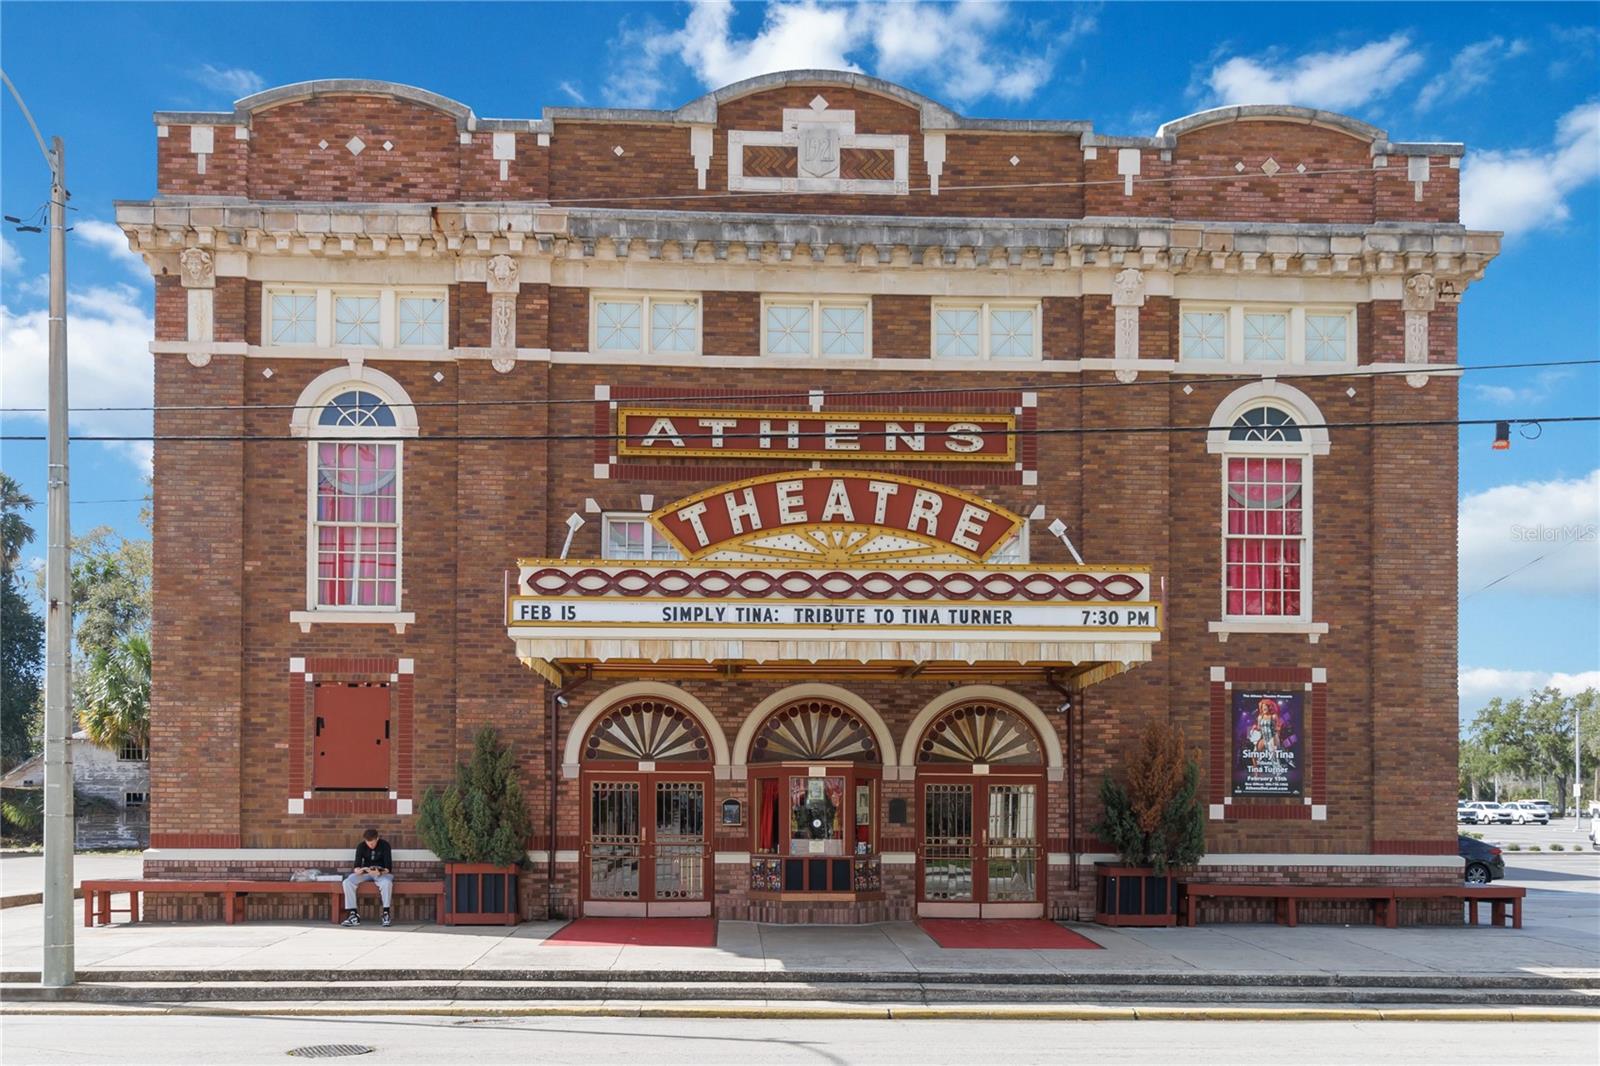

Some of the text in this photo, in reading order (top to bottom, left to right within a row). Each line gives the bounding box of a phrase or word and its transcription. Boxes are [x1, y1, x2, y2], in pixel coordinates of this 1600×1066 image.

[640, 418, 985, 453] ATHENS
[678, 479, 991, 552] THEATRE
[520, 605, 1149, 625] FEB 15 SIMPLY TINA: TRIBUTE TO TINA TURNER 7:30 PM
[1242, 749, 1294, 760] Simply Tina
